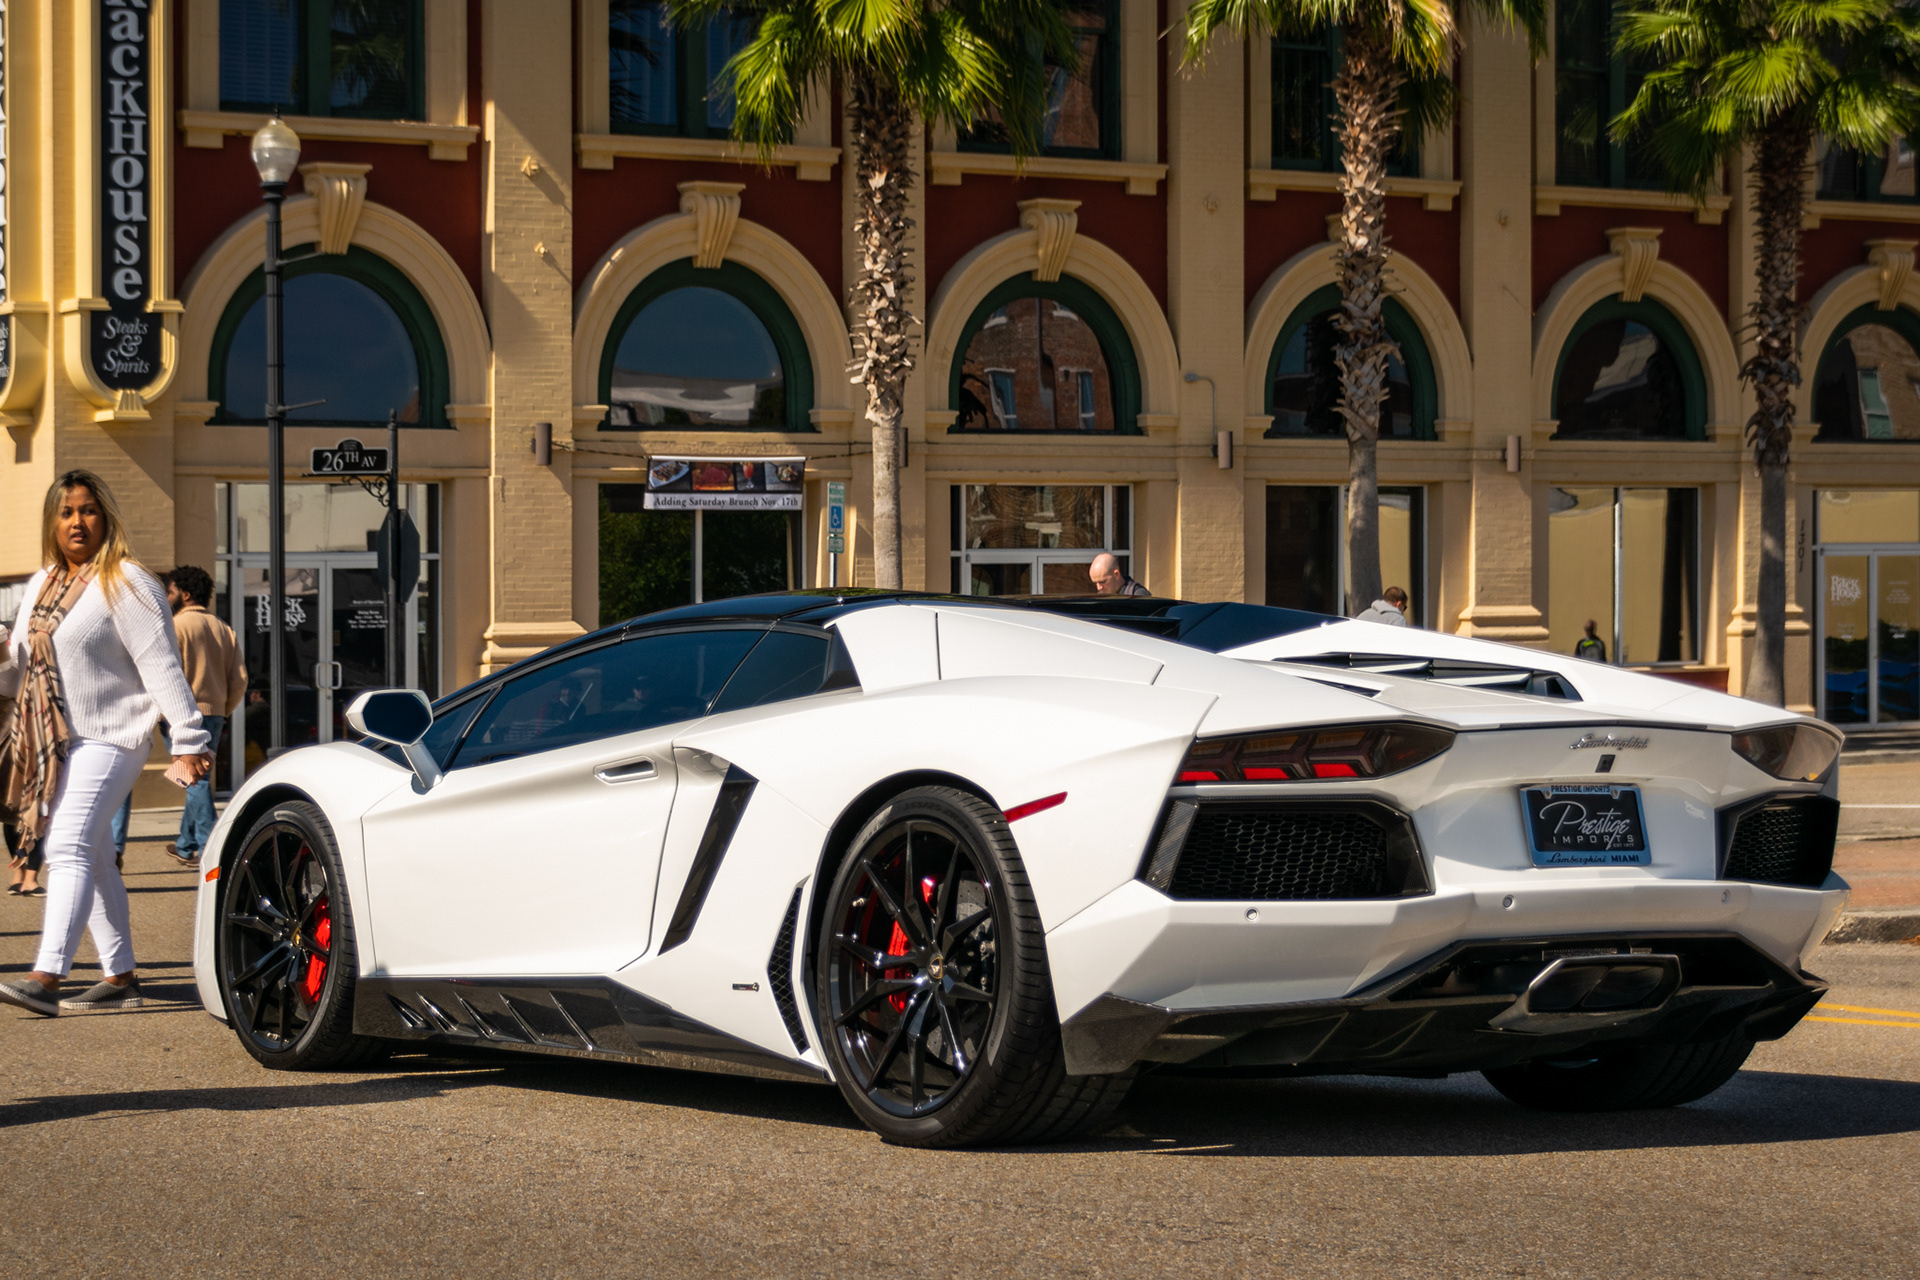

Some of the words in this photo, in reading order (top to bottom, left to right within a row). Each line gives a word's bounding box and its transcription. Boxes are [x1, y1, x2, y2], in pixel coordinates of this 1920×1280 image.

[107, 0, 147, 301] acKHouse
[103, 316, 149, 339] Steaks
[119, 334, 143, 357] &
[103, 348, 151, 378] Spirits
[361, 456, 377, 467] AV
[654, 497, 687, 508] Adding
[689, 498, 726, 508] Saturday
[729, 497, 759, 507] Brunch
[761, 497, 780, 507] Nov.
[782, 497, 799, 506] 17th
[1551, 785, 1582, 793] PRESTIGE
[1539, 801, 1630, 850] Prestige
[1552, 834, 1634, 844] IMPORTS
[1546, 853, 1606, 865] Lamborghini
[1611, 855, 1639, 863] MIAMI
